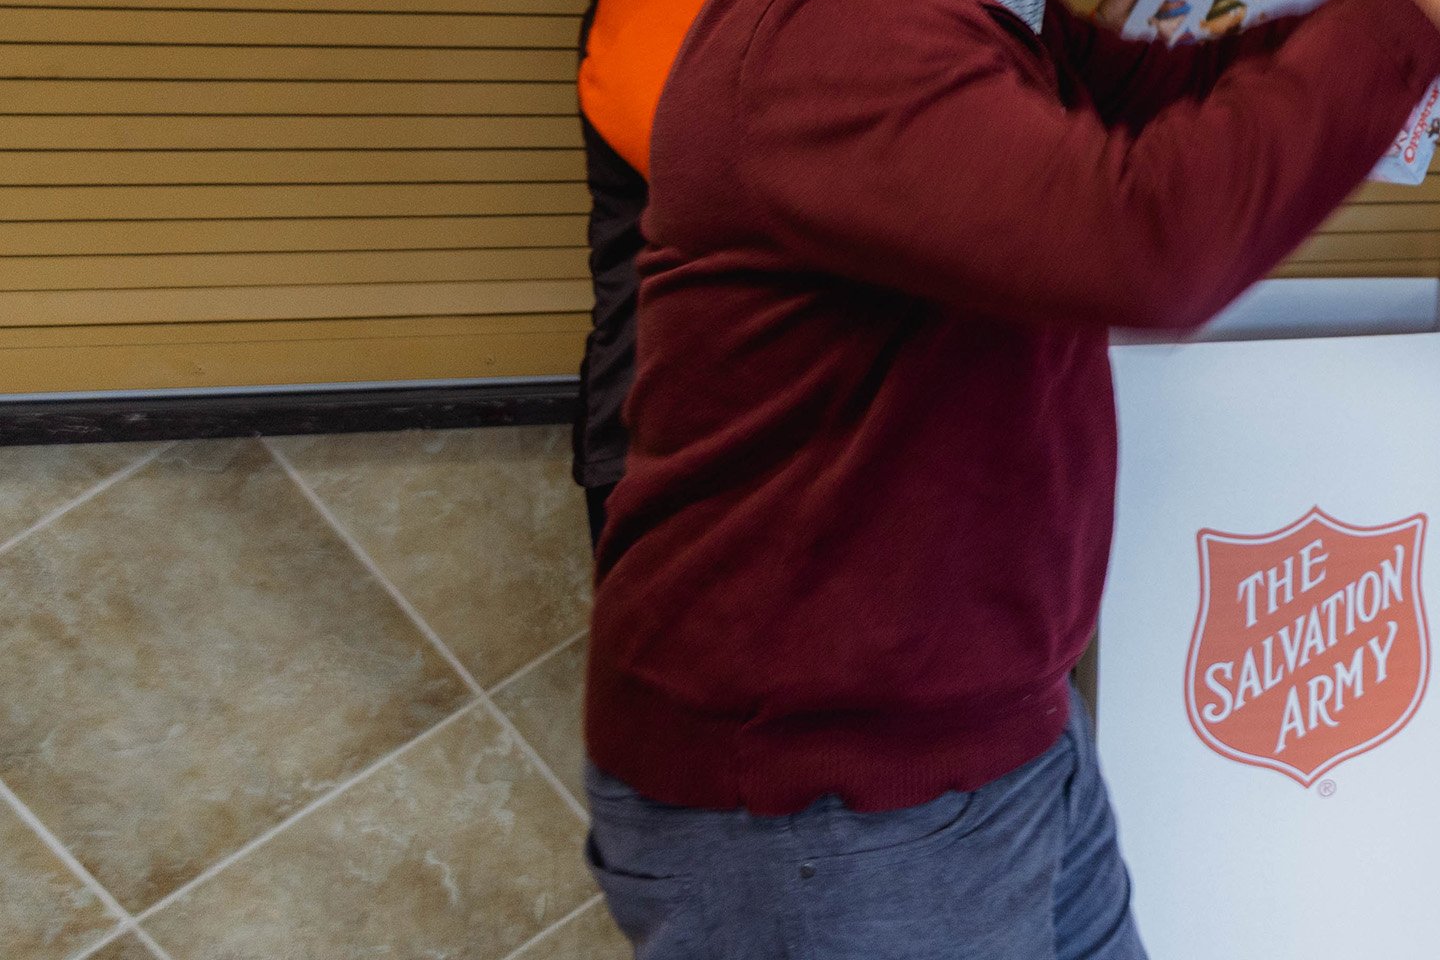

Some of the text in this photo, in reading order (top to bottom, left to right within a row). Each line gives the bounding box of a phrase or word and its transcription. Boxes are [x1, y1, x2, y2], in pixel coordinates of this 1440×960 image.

[1202, 544, 1405, 724] SALVATION
[1236, 539, 1329, 628] THE
[1273, 620, 1398, 754] ARMY
